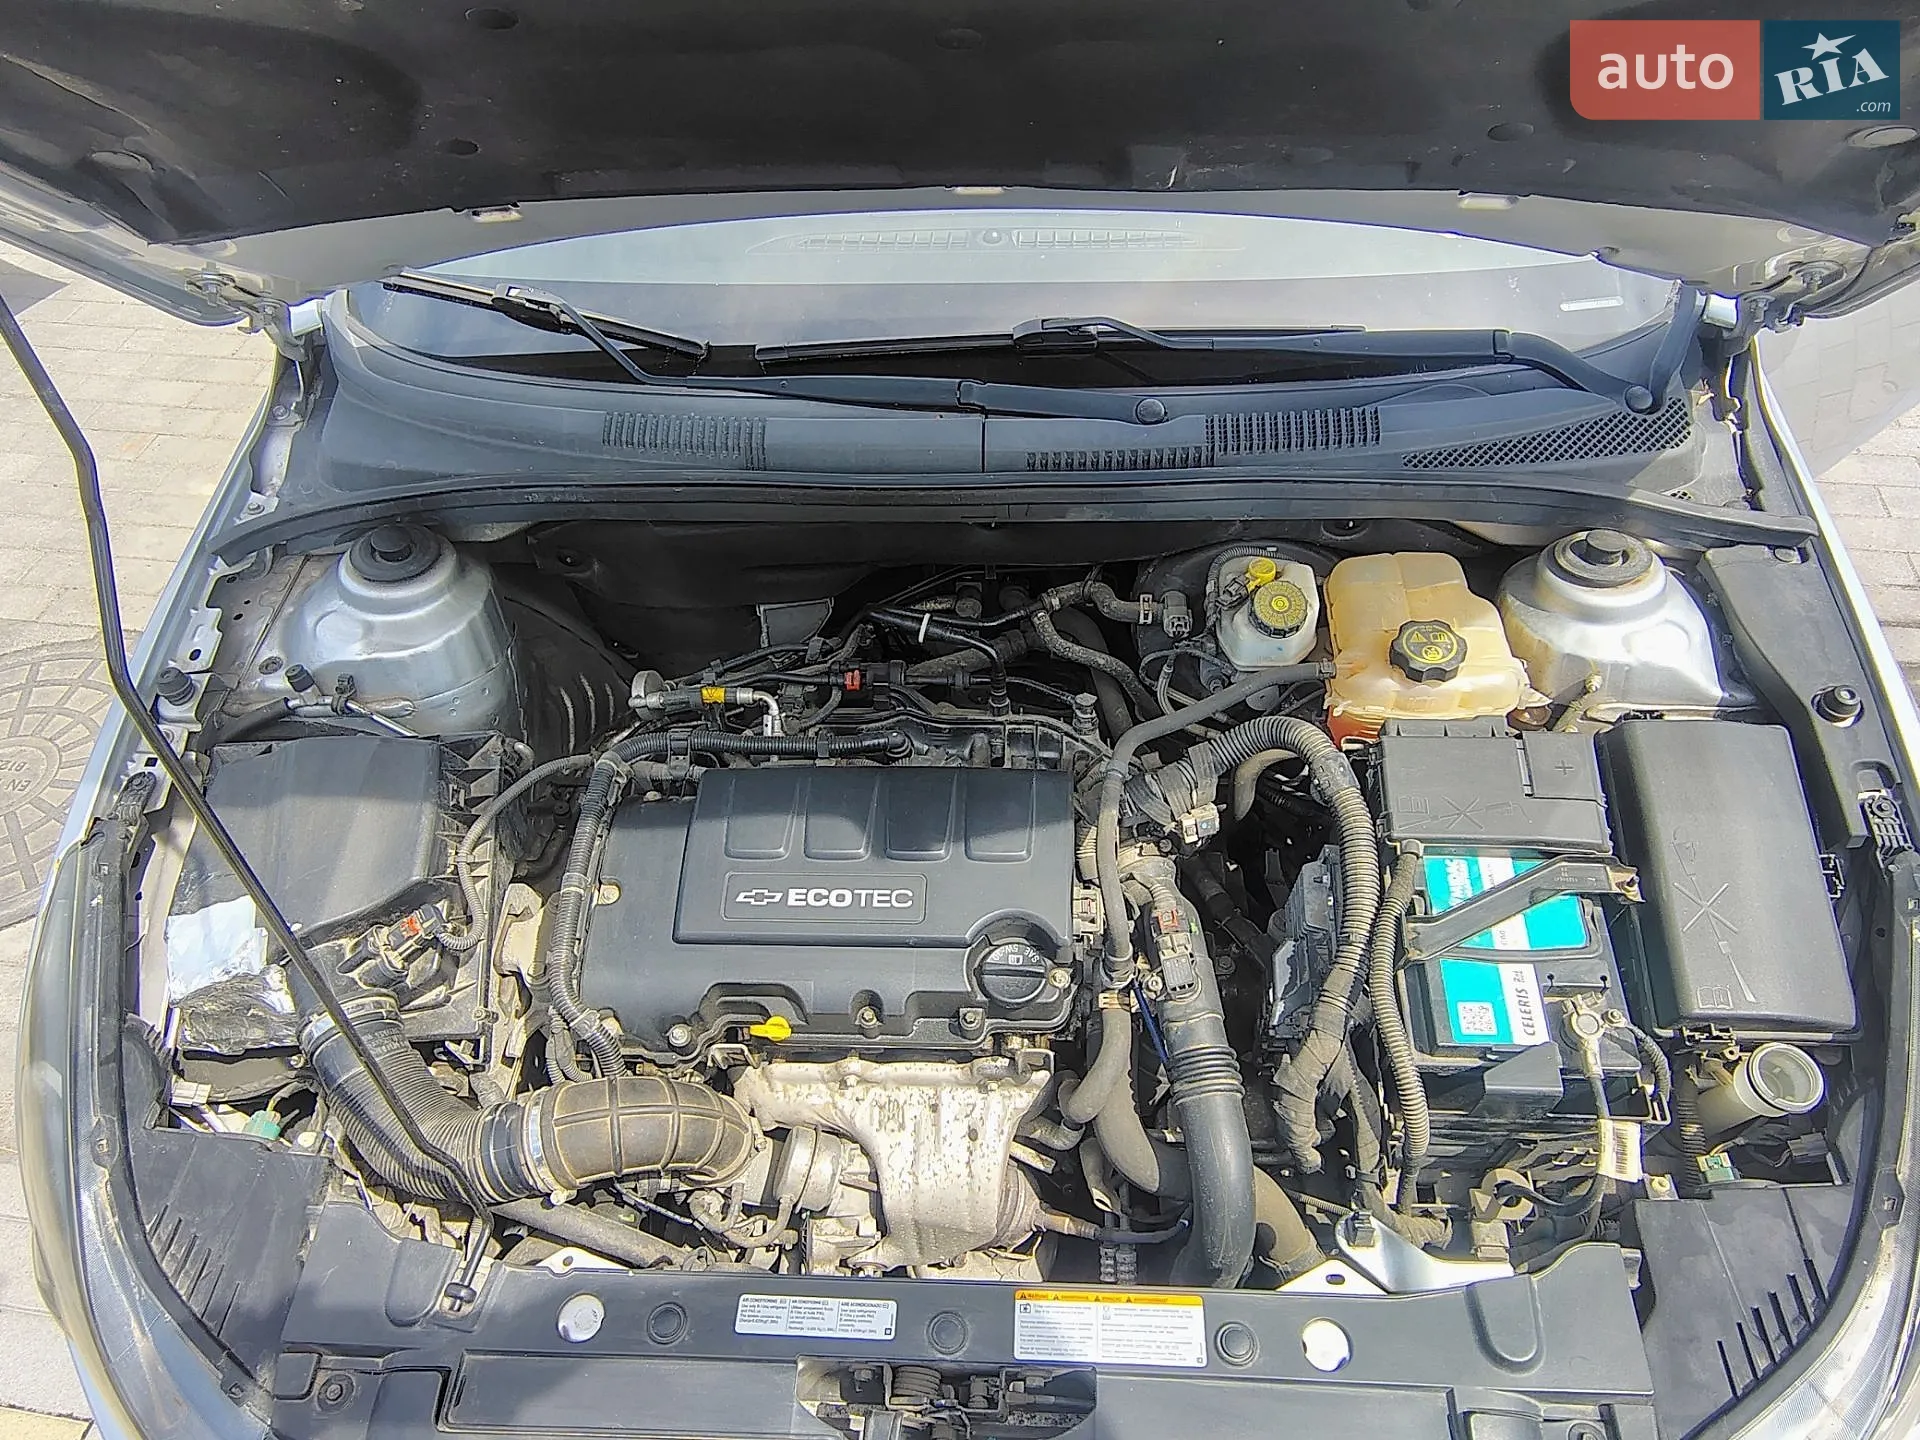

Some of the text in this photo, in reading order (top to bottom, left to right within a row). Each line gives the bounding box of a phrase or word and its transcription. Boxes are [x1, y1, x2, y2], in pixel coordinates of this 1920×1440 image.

[787, 888, 913, 908] ECOTEC
[1024, 946, 1040, 963] SAE
[1514, 987, 1536, 1037] CELERIS
